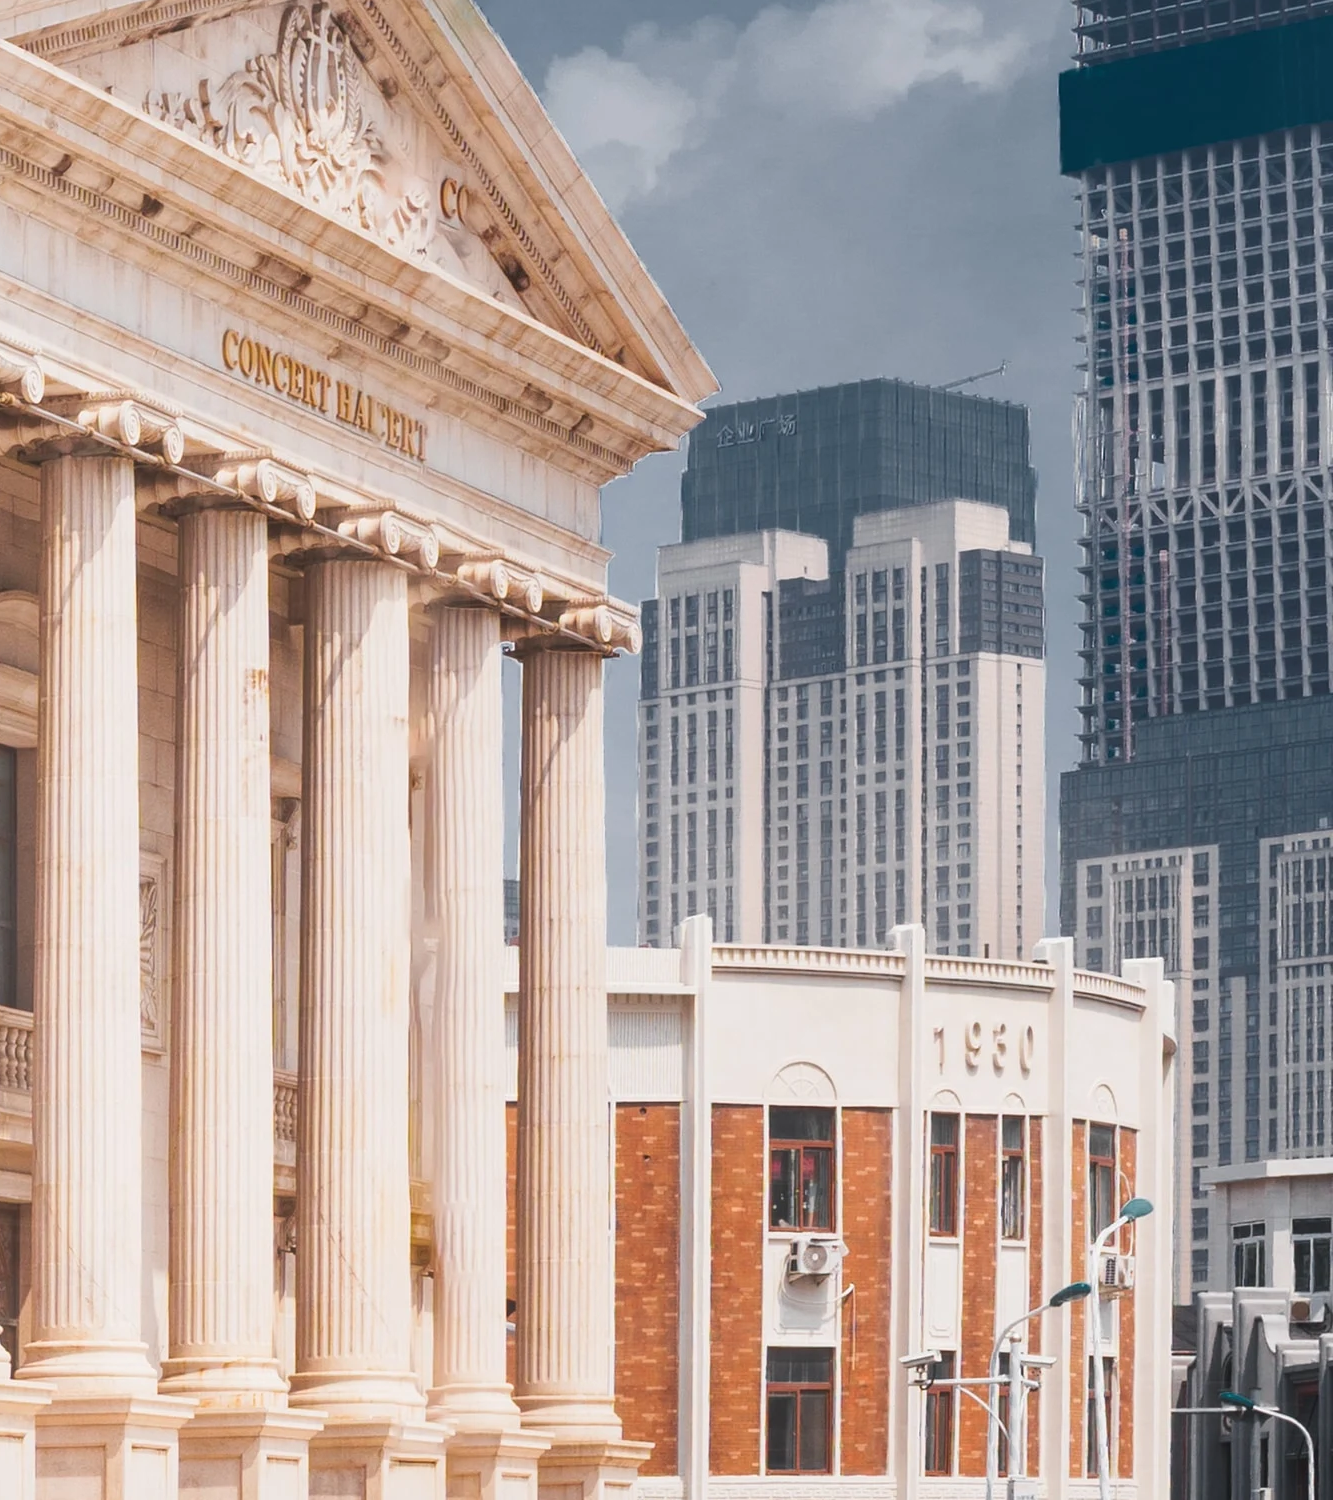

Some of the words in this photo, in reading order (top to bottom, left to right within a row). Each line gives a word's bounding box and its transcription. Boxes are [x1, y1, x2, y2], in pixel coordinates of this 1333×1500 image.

[222, 327, 332, 414] CONCERT
[717, 414, 798, 448] 企业广场
